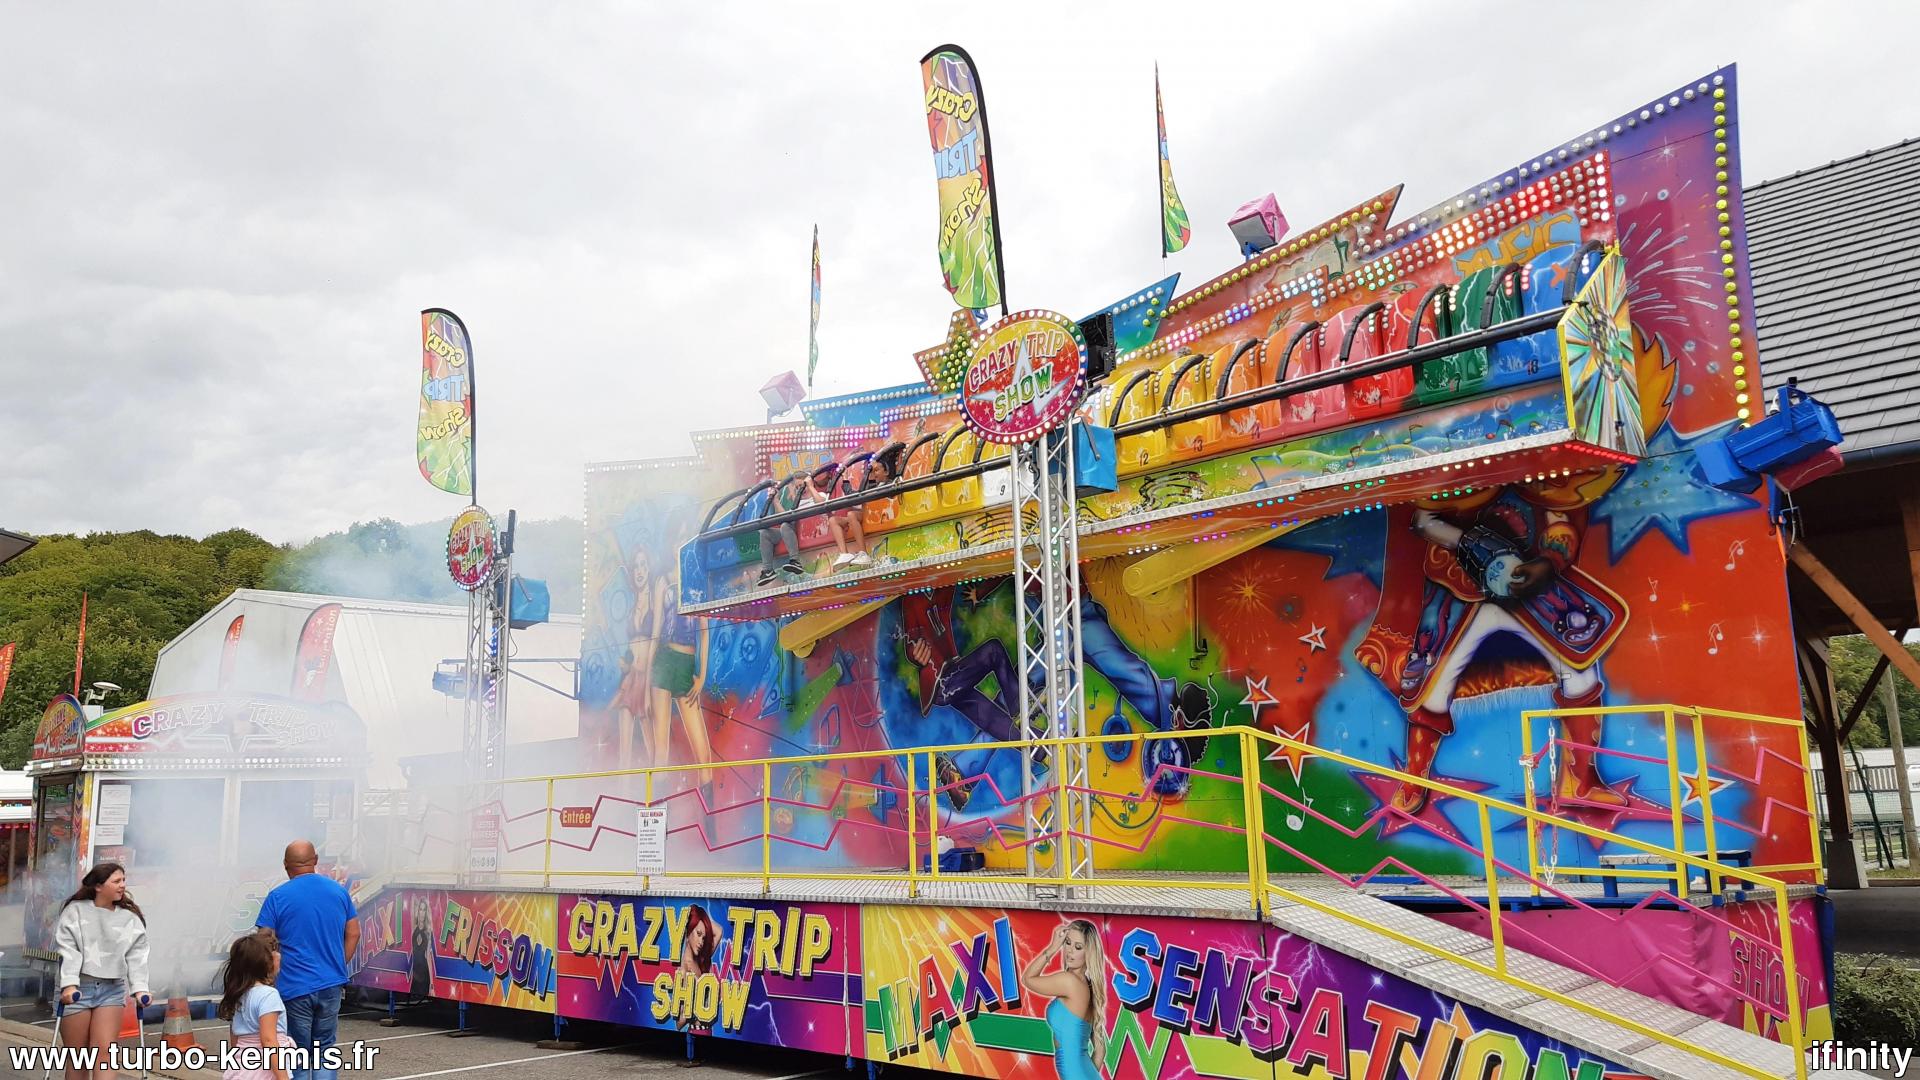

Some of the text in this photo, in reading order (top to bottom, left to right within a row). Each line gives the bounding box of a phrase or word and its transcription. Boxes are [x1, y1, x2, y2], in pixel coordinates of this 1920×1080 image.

[969, 329, 1065, 392] CRAZY TRIP
[993, 361, 1054, 422] SHOW
[1000, 484, 1006, 496] 9
[450, 522, 471, 554] CRAZY
[460, 540, 485, 577] SHOW
[131, 702, 224, 741] CRAZY
[562, 809, 592, 825] Entrée
[439, 898, 553, 1001] FRISSON
[567, 900, 833, 979] CRAZY TRIP
[651, 971, 750, 1031] SHOW
[878, 915, 1021, 1060] MAXI
